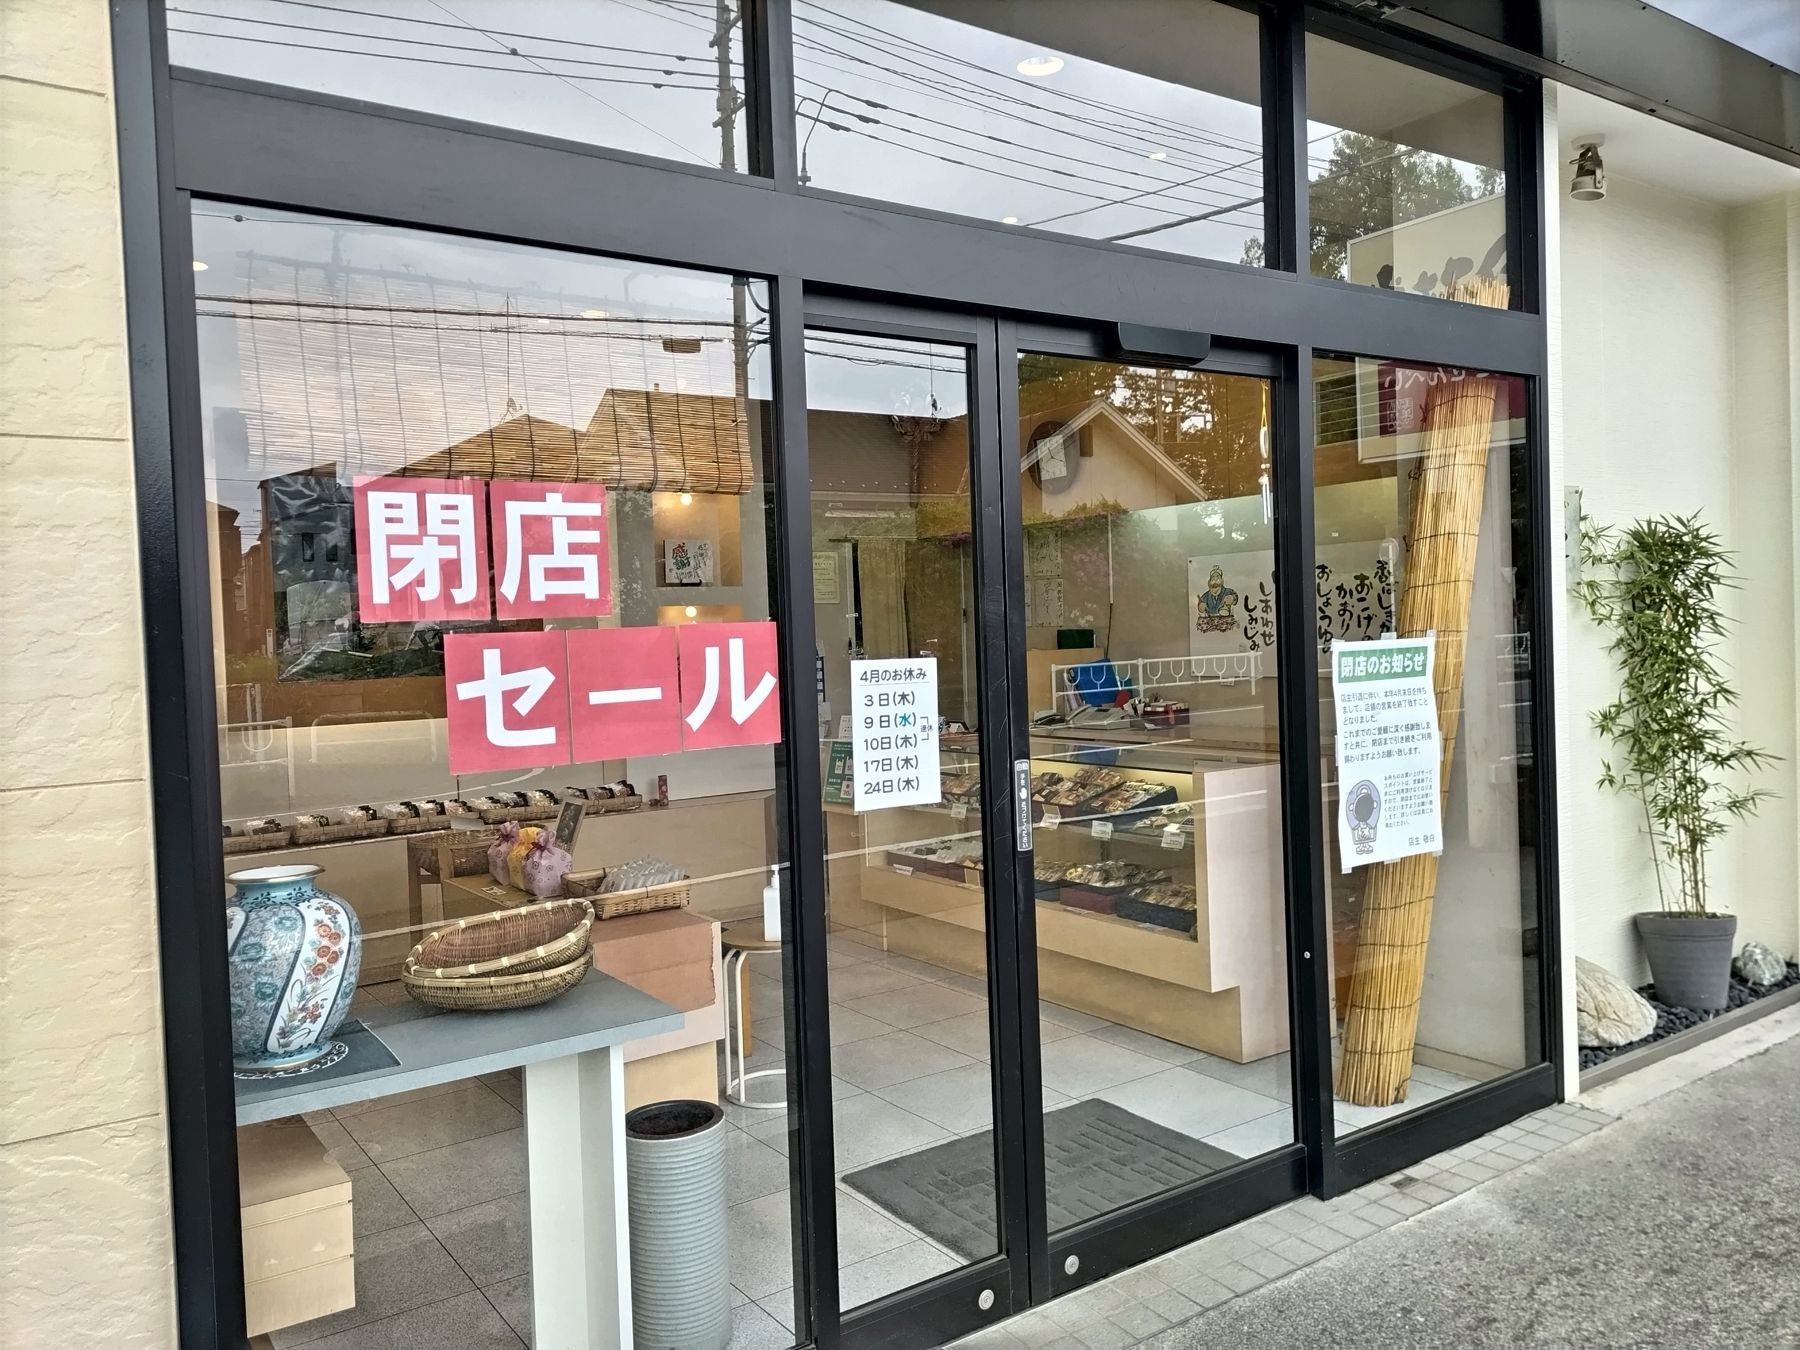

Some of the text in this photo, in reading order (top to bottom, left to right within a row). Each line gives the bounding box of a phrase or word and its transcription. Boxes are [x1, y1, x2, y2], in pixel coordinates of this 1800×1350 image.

[367, 491, 602, 605] 閉店
[1243, 595, 1260, 652] しみじみ
[455, 637, 777, 747] セール
[860, 667, 927, 683] 4月のお休み
[1340, 652, 1425, 678] 閉店のお知らせ
